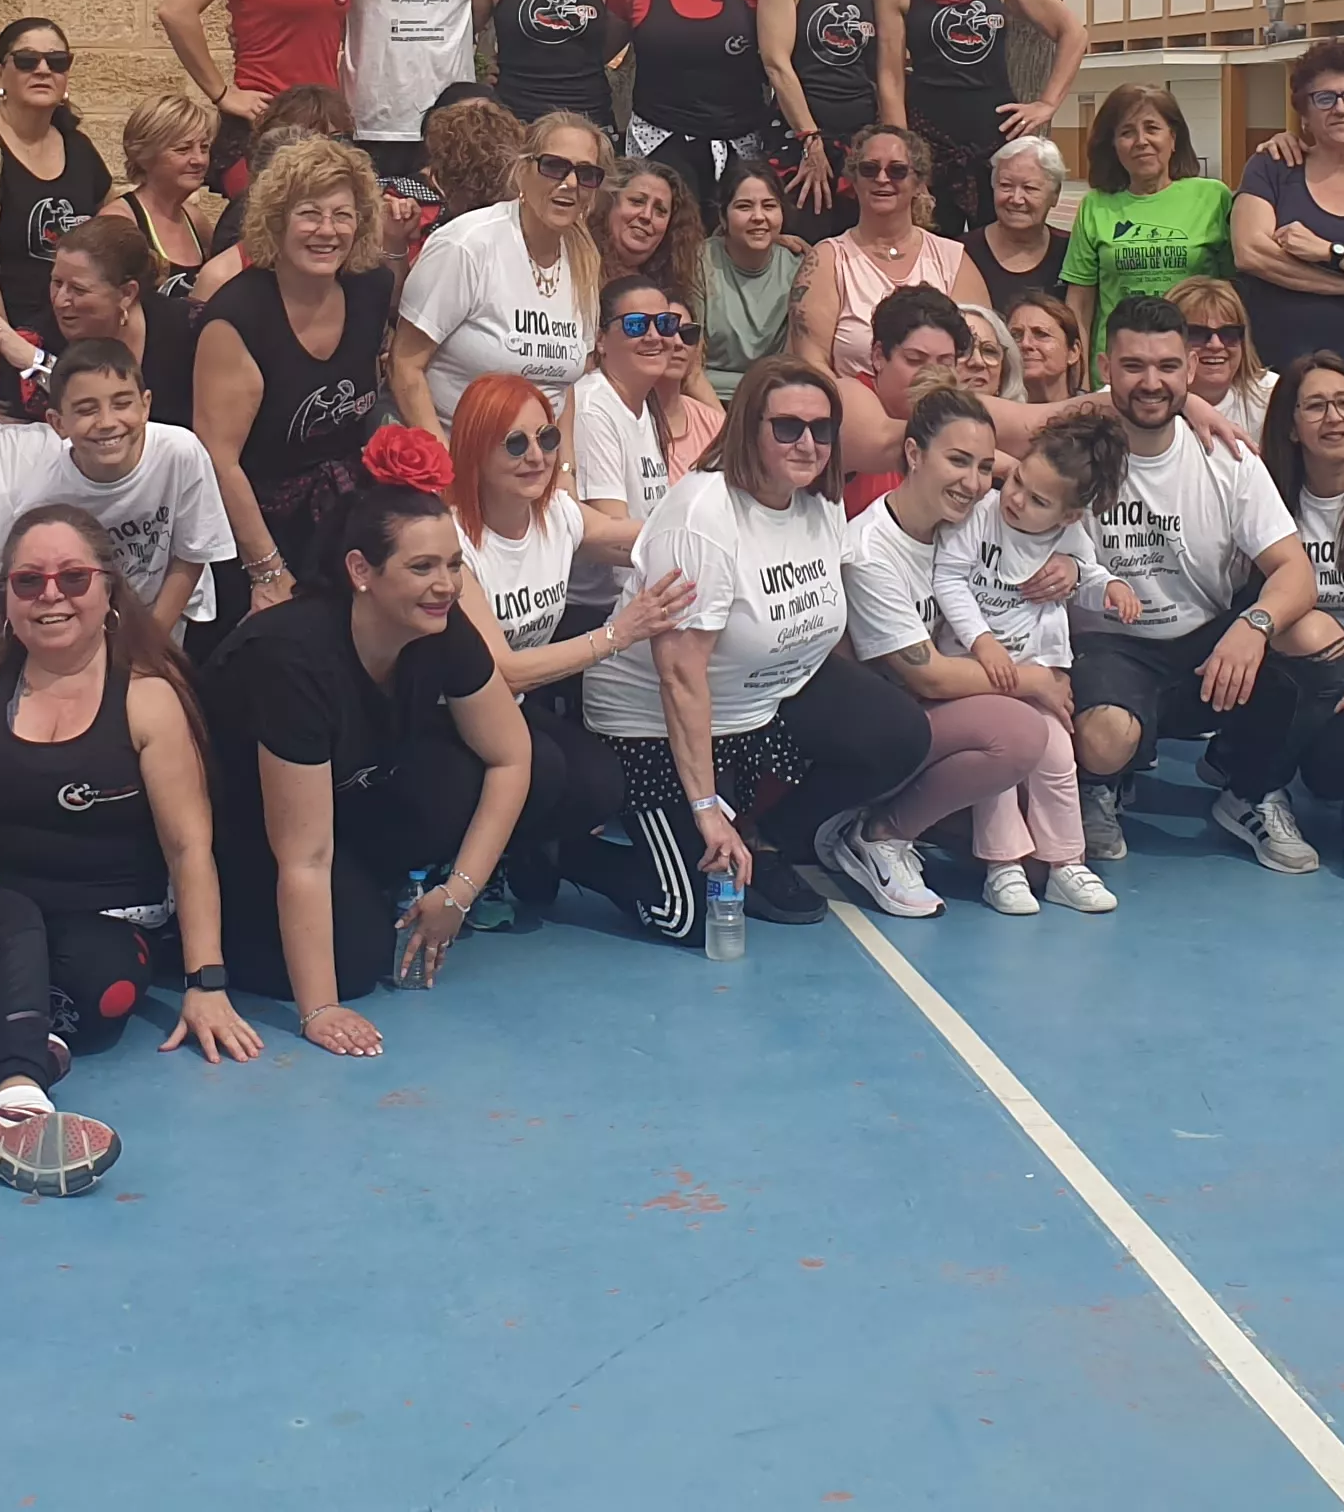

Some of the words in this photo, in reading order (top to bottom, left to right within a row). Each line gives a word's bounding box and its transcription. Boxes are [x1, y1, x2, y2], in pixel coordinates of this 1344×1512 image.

[1150, 257, 1161, 269] DE
[515, 309, 550, 335] una
[551, 321, 577, 338] entre
[519, 342, 533, 357] un
[537, 341, 568, 360] millón
[1101, 501, 1143, 525] una
[1147, 510, 1181, 532] entre
[108, 520, 140, 540] na
[1103, 534, 1119, 549] un
[1125, 530, 1165, 548] millón
[1109, 552, 1165, 571] Gabriella
[1302, 541, 1335, 563] na
[759, 561, 794, 595] una
[794, 558, 827, 585] entre
[495, 586, 532, 620] una
[769, 604, 786, 621] un
[916, 595, 940, 622] un
